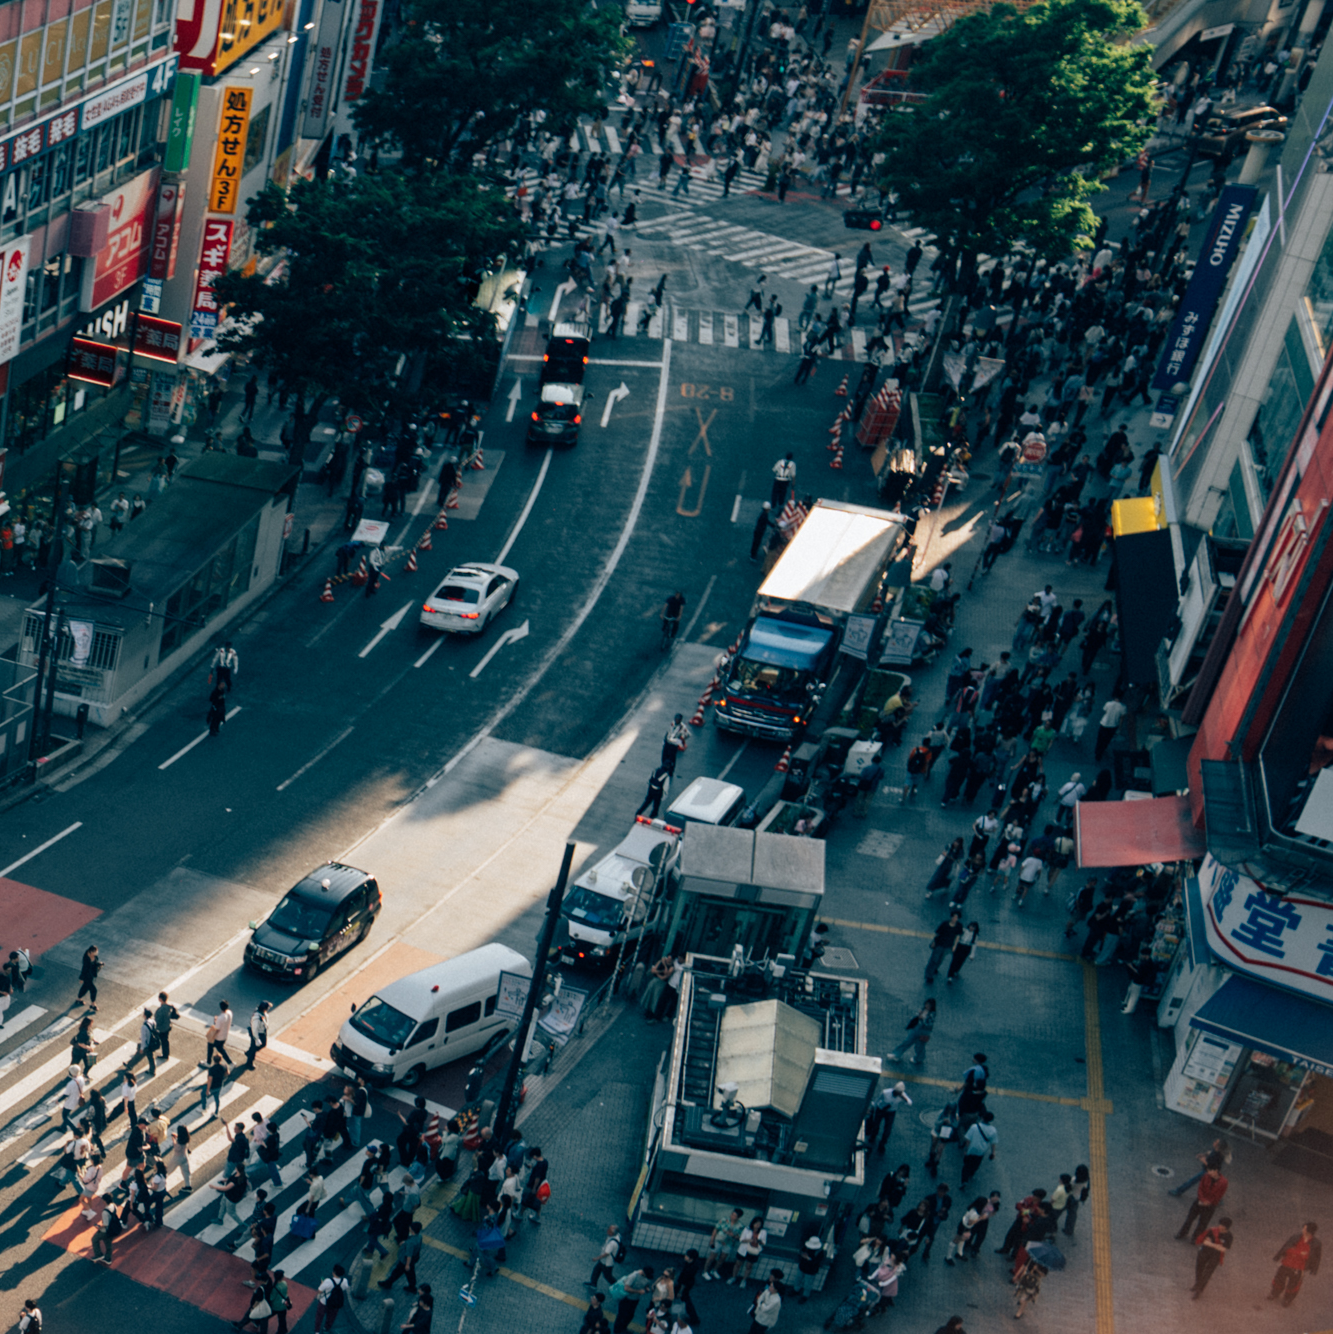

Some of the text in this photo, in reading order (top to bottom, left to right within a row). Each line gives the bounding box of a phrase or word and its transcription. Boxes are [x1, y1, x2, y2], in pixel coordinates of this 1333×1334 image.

[152, 58, 175, 93] 4F
[172, 108, 183, 137] レイク
[217, 90, 247, 177] 処方せん
[216, 181, 231, 209] 3F
[104, 221, 142, 268] アコム
[153, 223, 170, 260] アコム
[1210, 203, 1244, 266] MIZUHO
[1166, 311, 1199, 375] みずほ銀行
